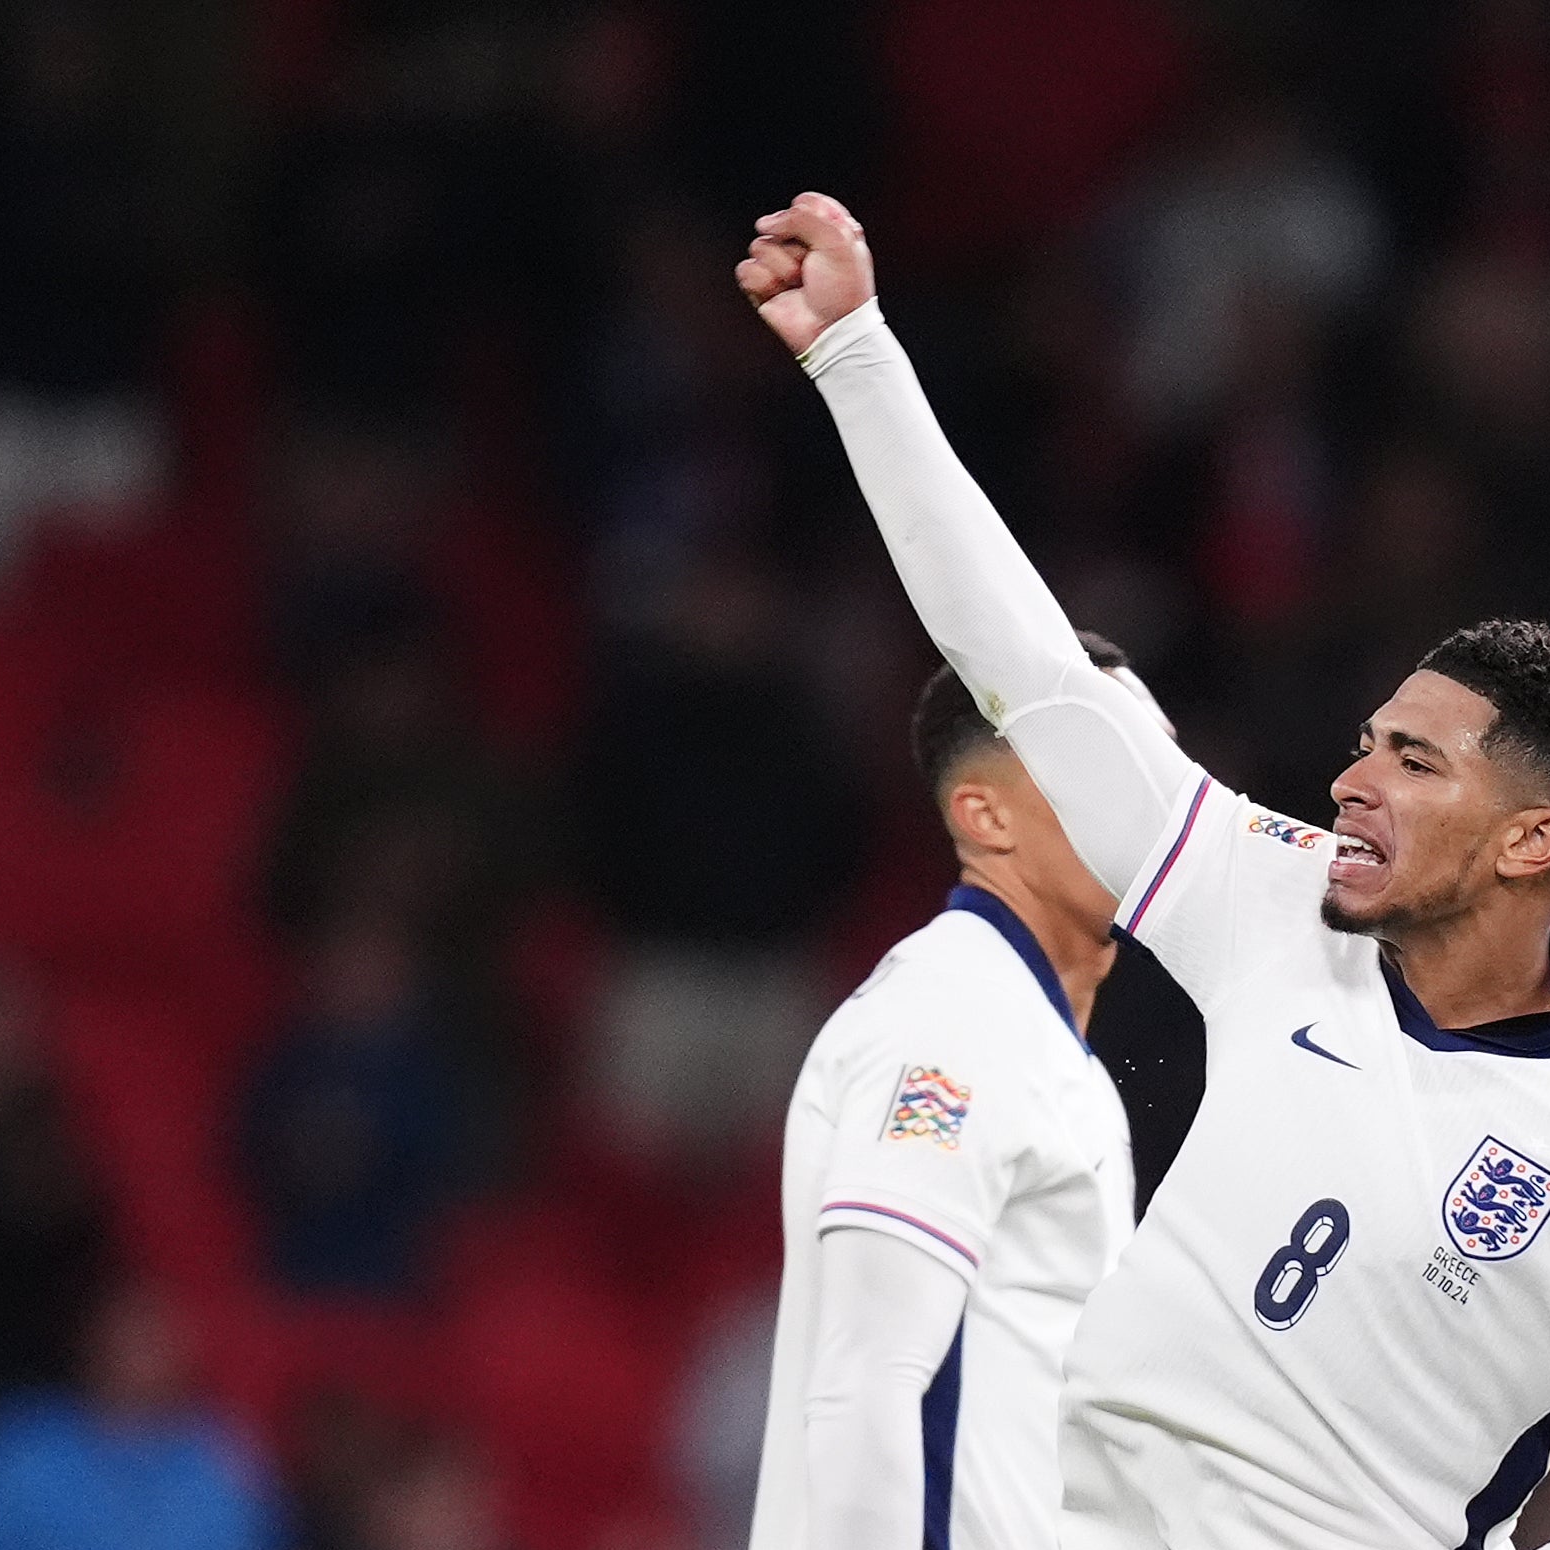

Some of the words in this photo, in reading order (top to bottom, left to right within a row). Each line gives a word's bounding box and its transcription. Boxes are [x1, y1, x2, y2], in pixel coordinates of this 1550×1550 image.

[1254, 1197, 1350, 1331] 8
[1421, 1263, 1470, 1305] 10.10.24
[1433, 1246, 1481, 1286] GREECE
